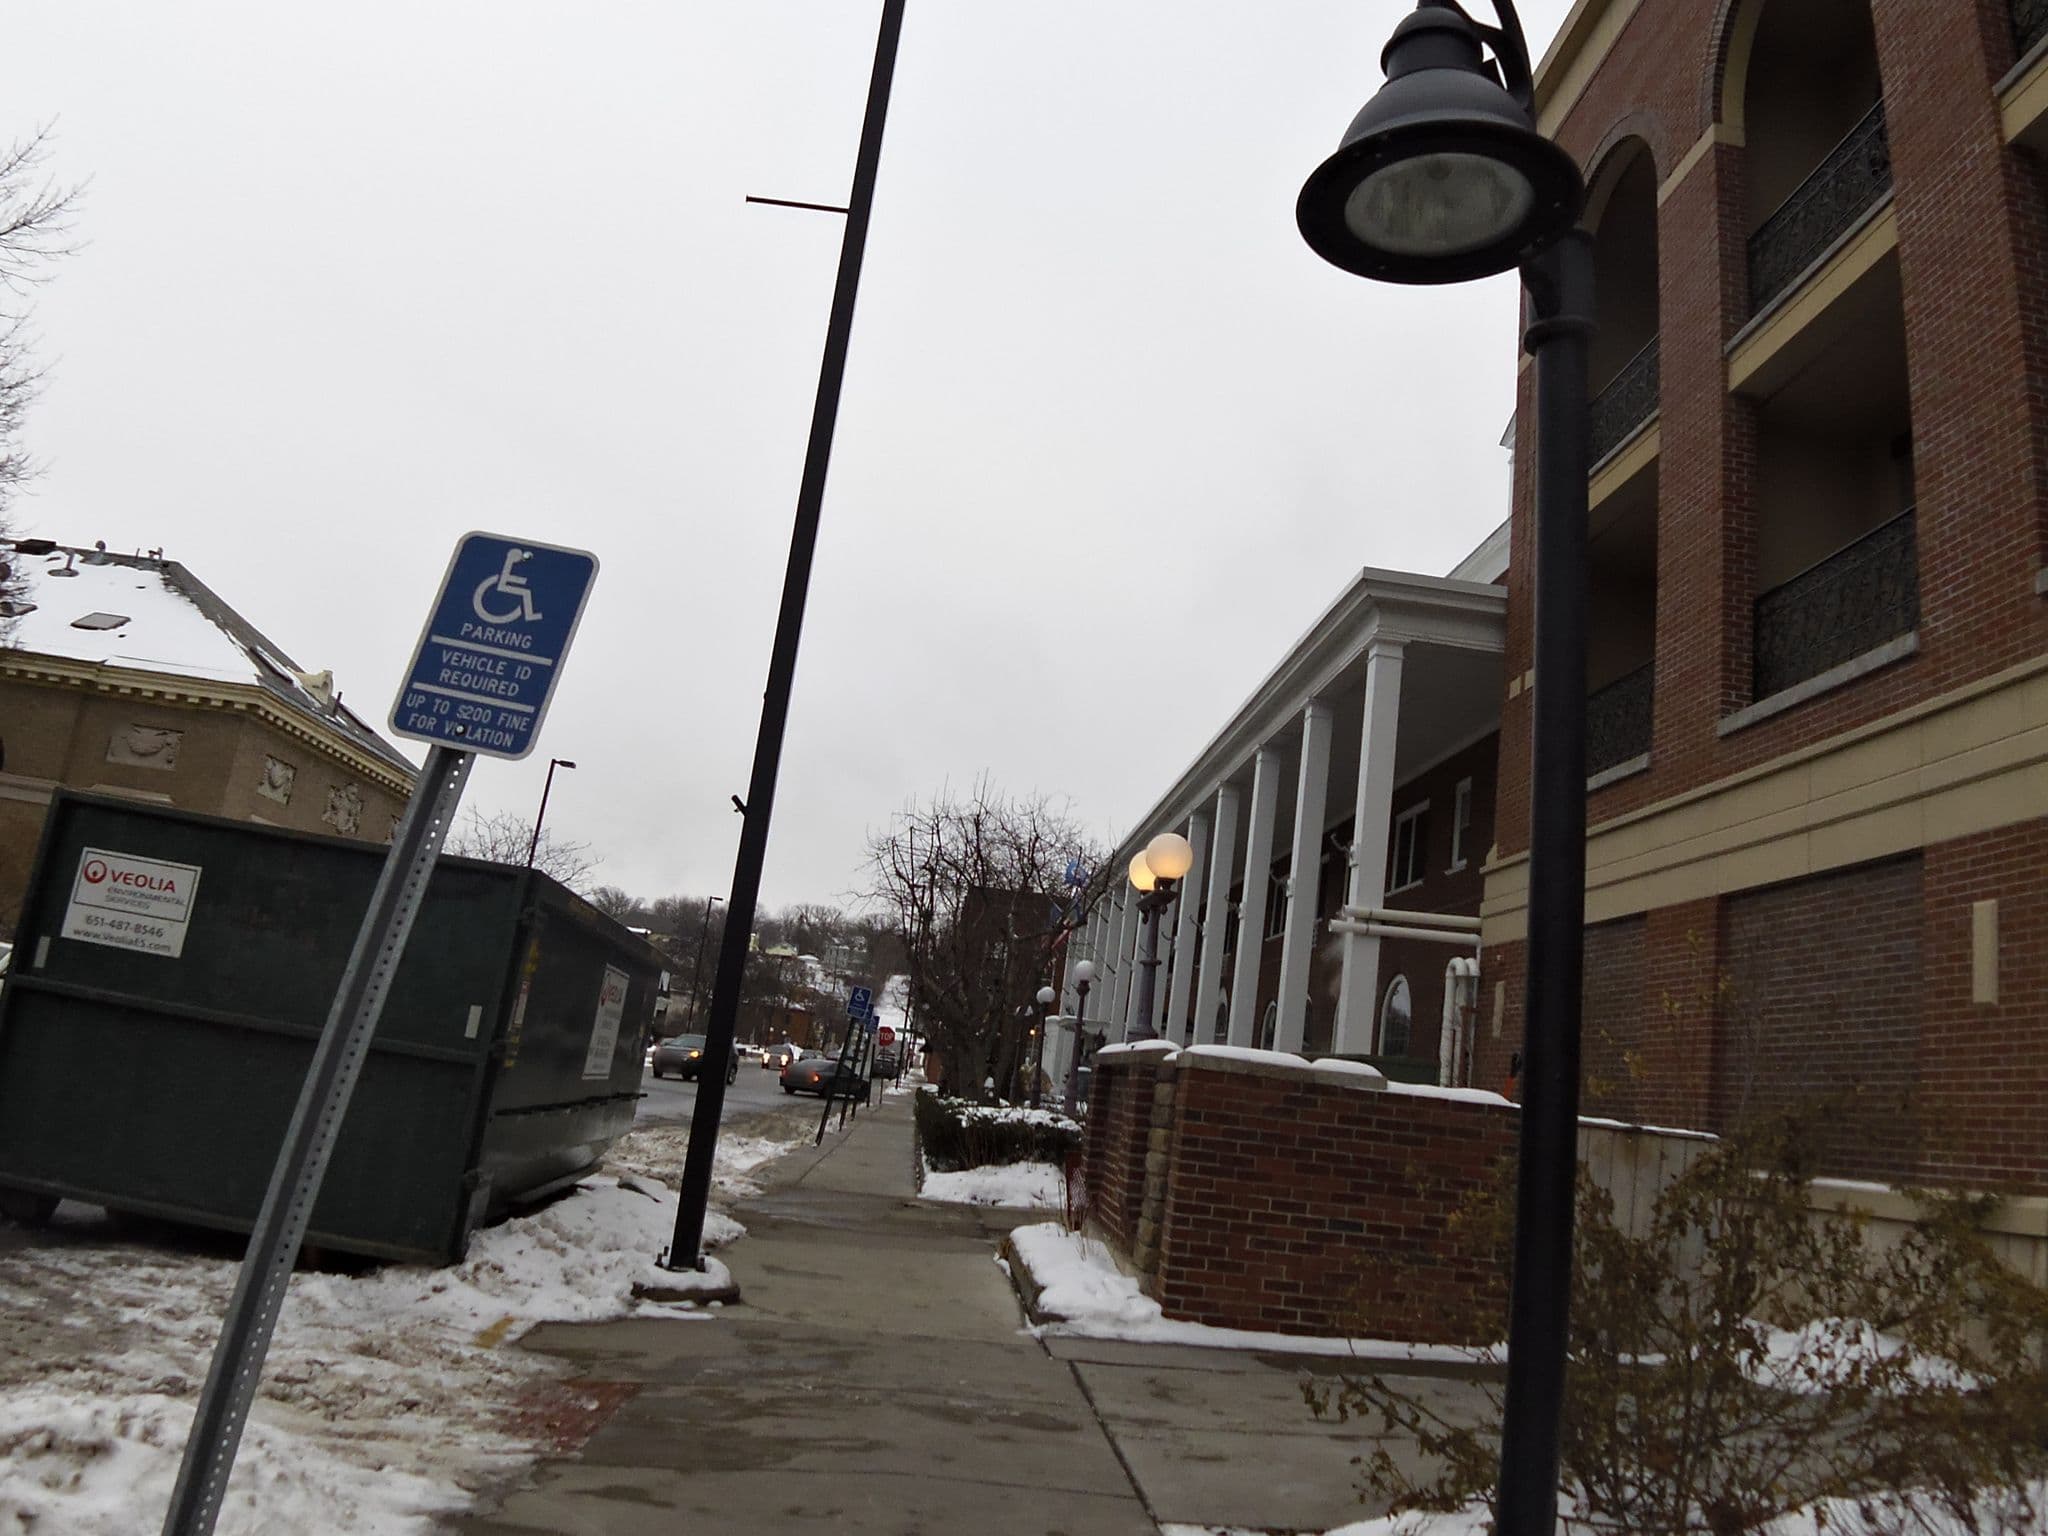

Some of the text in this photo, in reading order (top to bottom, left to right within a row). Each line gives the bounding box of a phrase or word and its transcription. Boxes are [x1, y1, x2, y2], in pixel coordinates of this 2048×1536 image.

[460, 623, 532, 649] PARKING
[441, 650, 532, 681] VEHICLE ID
[439, 669, 520, 697] REQUIRED
[406, 693, 531, 732] UP TO $200 FINE
[408, 714, 515, 748] FOR VILATION
[111, 870, 176, 893] VEOLIA
[86, 915, 164, 938] 651-487-8546
